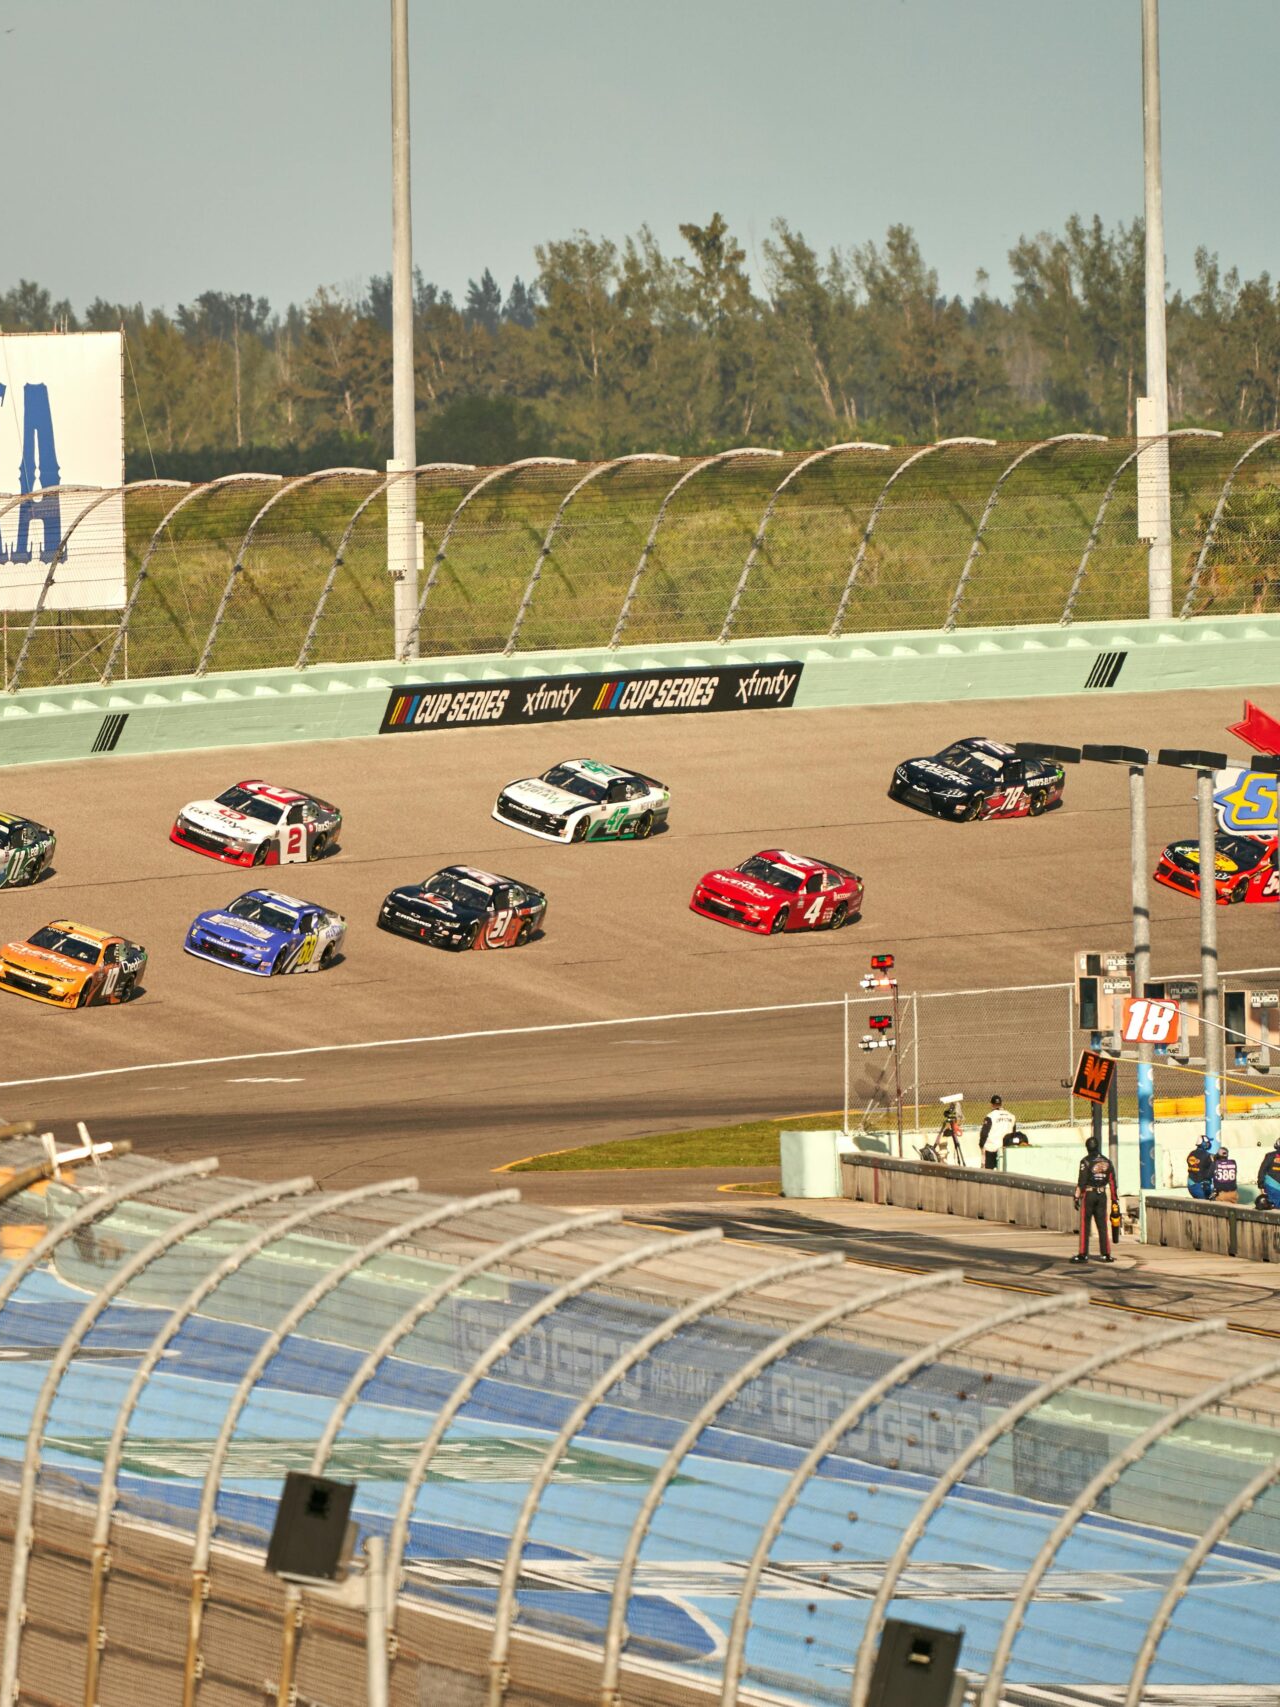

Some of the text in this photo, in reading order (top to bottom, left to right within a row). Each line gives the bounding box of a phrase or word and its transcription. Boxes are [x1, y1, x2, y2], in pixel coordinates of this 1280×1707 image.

[522, 683, 582, 715] xfinity
[619, 676, 720, 710] CUP SERIES
[735, 669, 797, 704] xfinity
[413, 689, 510, 724] CUP SERIES
[1000, 786, 1025, 811] 78
[1235, 778, 1278, 821] S
[188, 805, 257, 836] TaxSlayer
[606, 806, 631, 833] 47
[287, 827, 302, 855] 2
[8, 850, 26, 880] 11
[712, 873, 775, 900] SWENSON
[803, 895, 826, 924] 4
[488, 910, 513, 939] 51
[1106, 958, 1135, 967] musco
[101, 967, 120, 996] 10
[1103, 982, 1132, 990] musco
[1251, 995, 1279, 1004] musco
[1125, 1000, 1176, 1041] 18
[875, 1399, 984, 1479] GEICO
